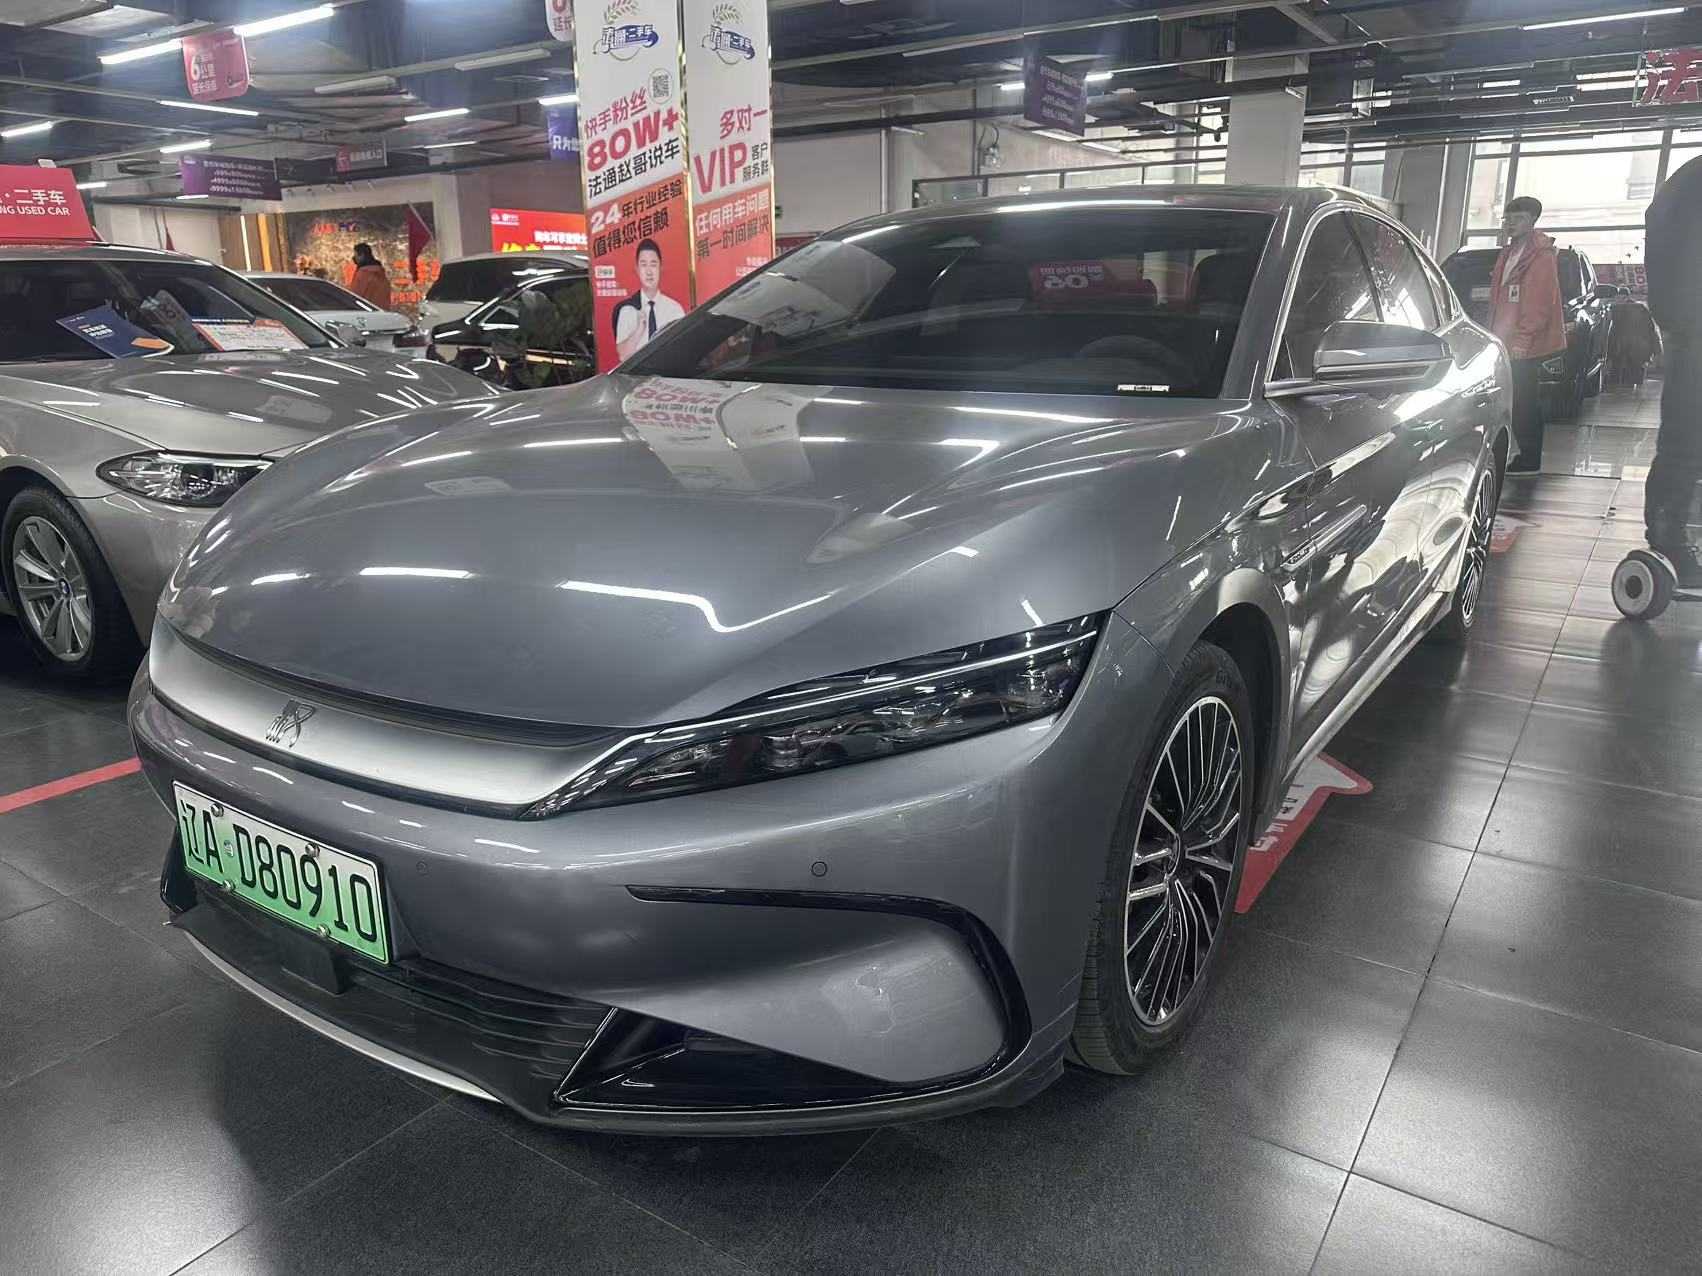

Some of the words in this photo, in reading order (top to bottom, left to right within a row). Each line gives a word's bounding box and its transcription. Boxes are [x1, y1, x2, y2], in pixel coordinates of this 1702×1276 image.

[584, 86, 648, 139] 快手粉丝
[719, 104, 768, 140] 多对一
[586, 107, 679, 172] 80W+
[588, 137, 680, 198] 法通赵哥说车
[693, 142, 748, 194] VIP
[17, 206, 46, 215] USED
[47, 207, 71, 216] CAR
[593, 207, 670, 258] 值得您信赖
[695, 188, 769, 237] 任何用车问题
